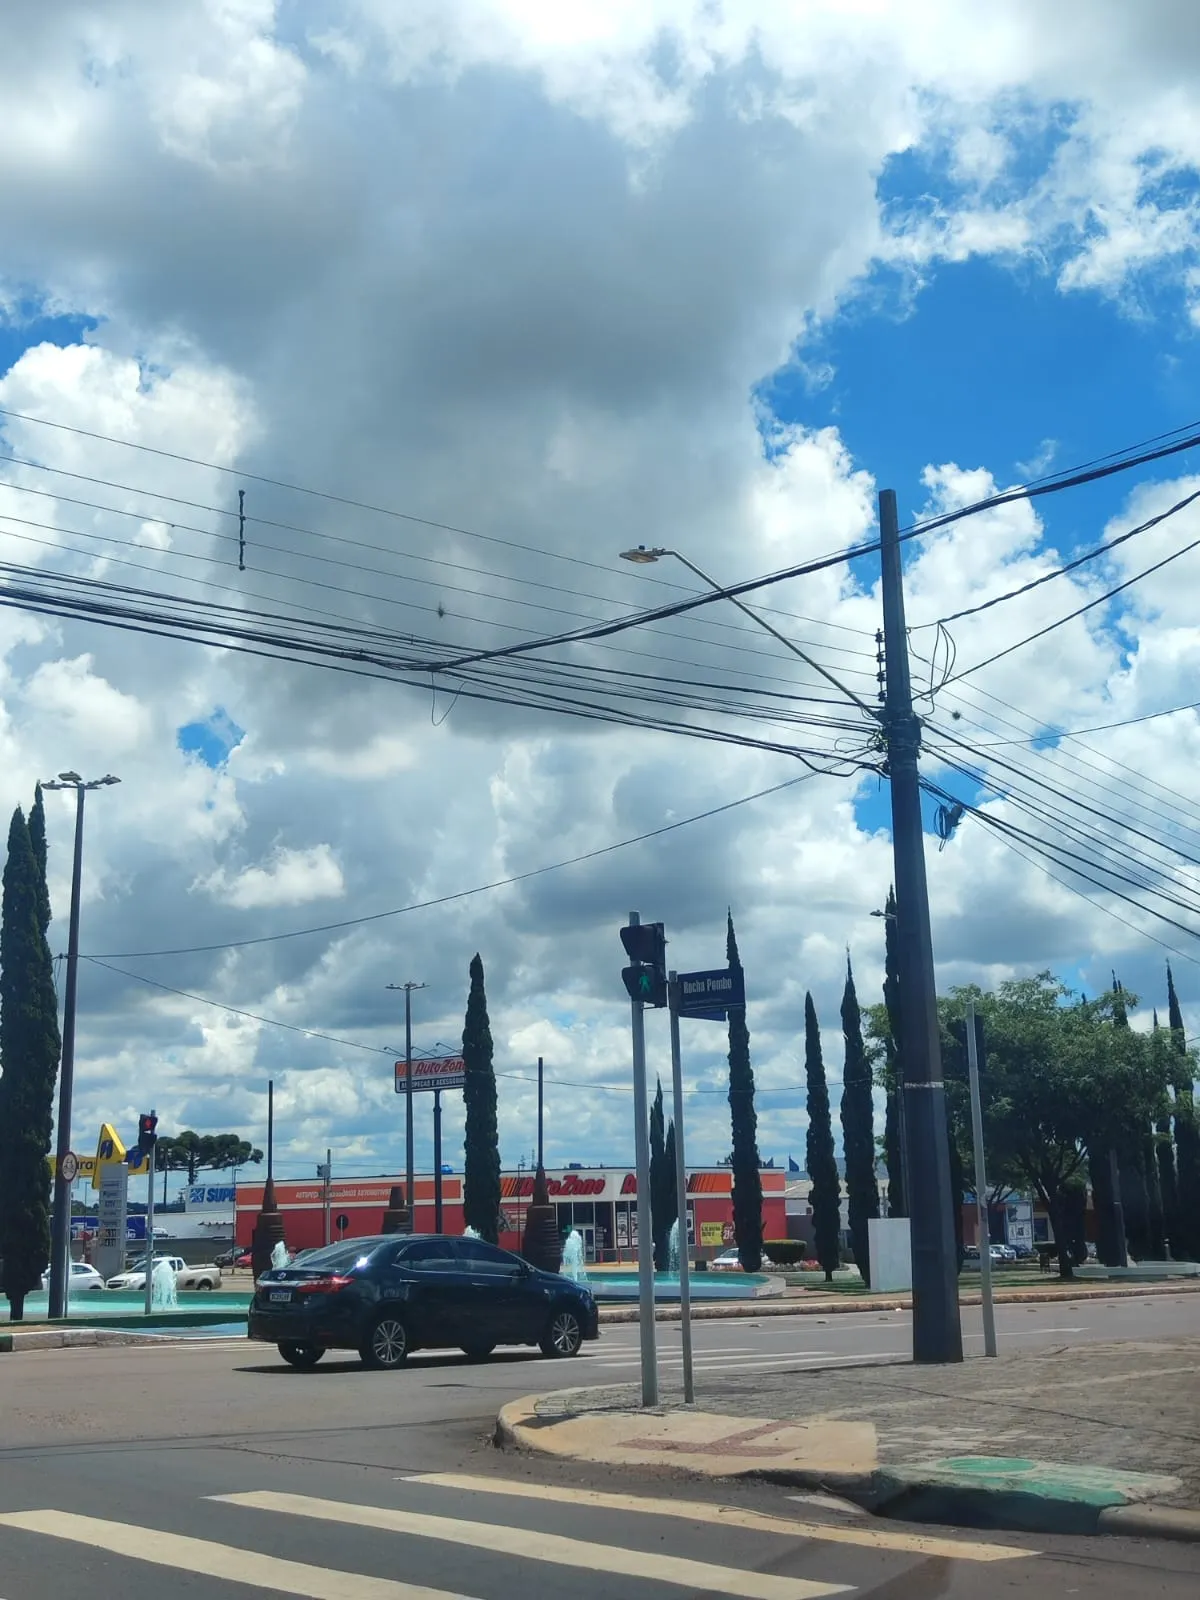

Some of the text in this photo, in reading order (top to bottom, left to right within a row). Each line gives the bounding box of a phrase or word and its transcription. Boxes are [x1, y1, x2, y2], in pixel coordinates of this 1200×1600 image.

[683, 976, 732, 994] Rocha Pombo
[415, 1059, 465, 1075] AutoZon
[518, 1174, 605, 1196] AtoZone
